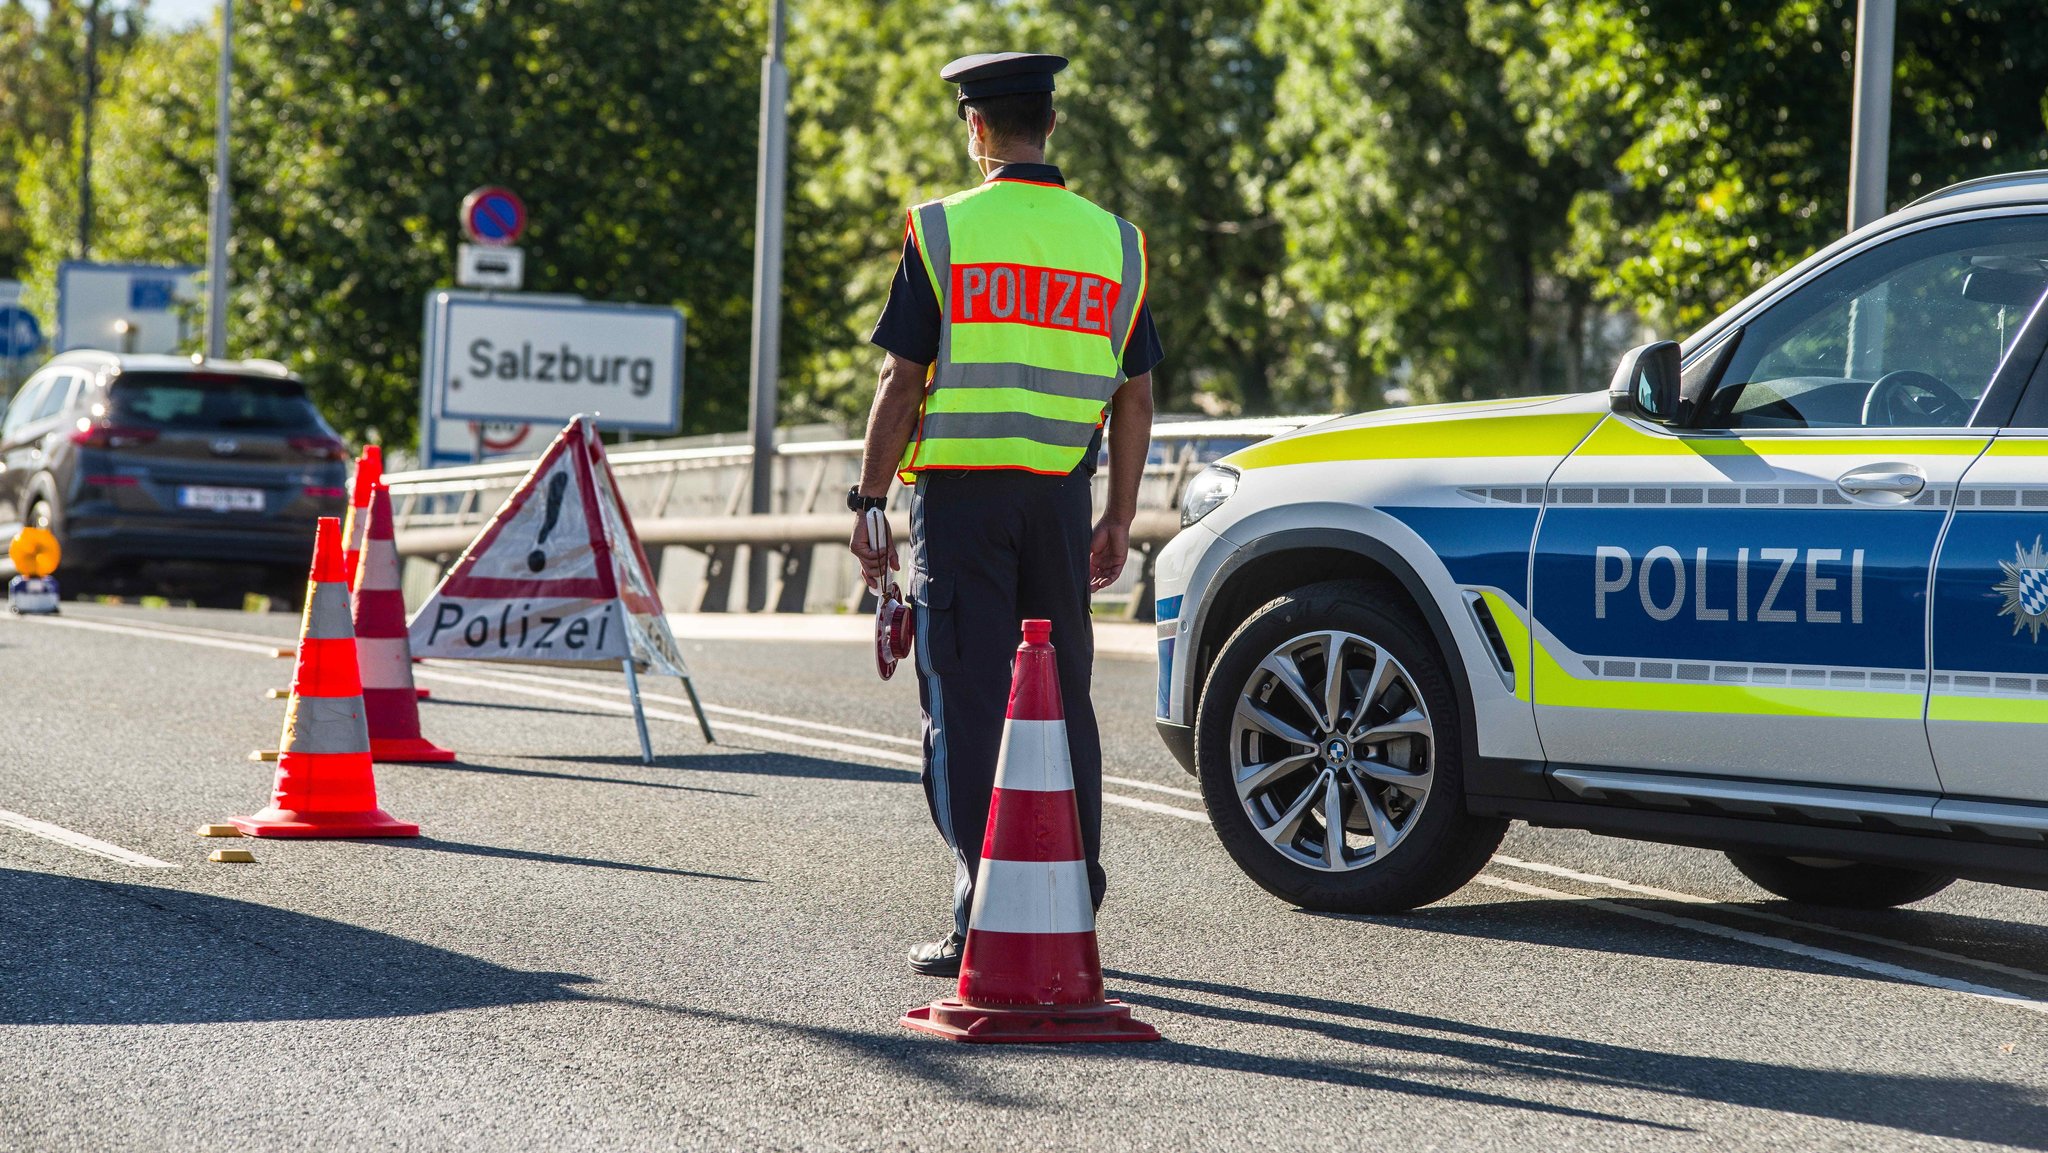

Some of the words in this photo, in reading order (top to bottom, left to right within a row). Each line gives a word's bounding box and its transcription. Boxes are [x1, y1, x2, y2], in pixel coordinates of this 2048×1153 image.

[962, 267, 1112, 331] POLIZEI
[468, 338, 653, 397] Salzburg
[1595, 545, 1865, 624] POLIZEI
[428, 603, 612, 650] Polizei
